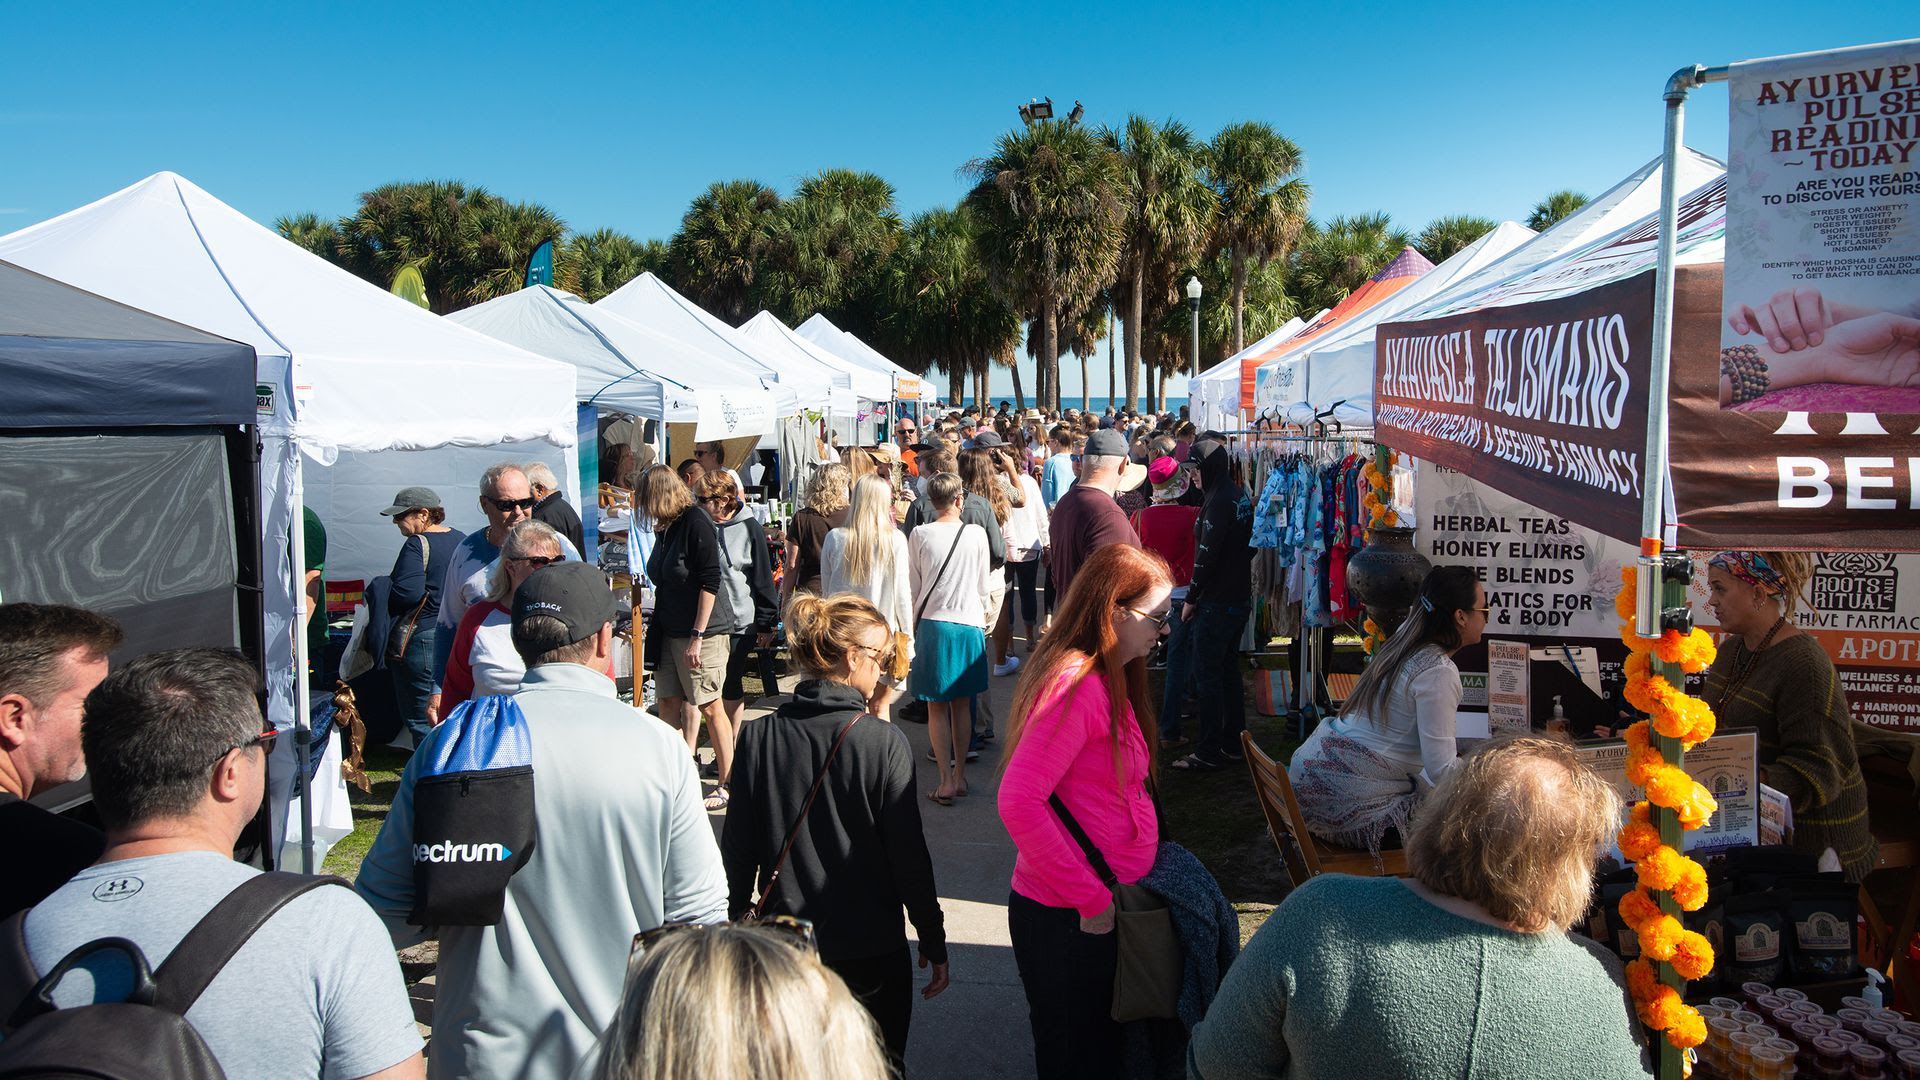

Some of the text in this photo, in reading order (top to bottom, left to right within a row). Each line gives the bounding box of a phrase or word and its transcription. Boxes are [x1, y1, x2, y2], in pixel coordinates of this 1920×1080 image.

[1757, 63, 1920, 106] AYURVE
[1804, 89, 1920, 125] PULSE
[1810, 141, 1917, 171] TODAY
[1795, 171, 1920, 192] ARE YOU READY
[1761, 194, 1782, 206] TO
[1786, 188, 1864, 204] DISCOVER
[1810, 208, 1846, 216] STRESS
[1863, 203, 1909, 213] ANXIETY?
[1823, 211, 1892, 222] OVER WEIGHT?
[1813, 217, 1902, 229] DIGESTIVE ISSUES?
[1820, 224, 1897, 235] SHORT TEMPER?
[1844, 237, 1893, 246] FLASHES?
[1850, 231, 1889, 239] ISSUES?
[1832, 244, 1883, 253] INSOMNIA?
[1762, 261, 1801, 269] IDENTIFY
[1879, 255, 1920, 263] CAUSING
[1826, 264, 1852, 272] WHAT
[1854, 263, 1873, 271] YOU
[1825, 271, 1851, 279] BACK
[1876, 268, 1920, 276] BALANCE
[1382, 313, 1630, 430] AYAHUASCA TALISMANS
[1377, 403, 1641, 498] AYURVEDA APOTHECARY & BEEHIVE FARMACY
[1776, 456, 1920, 510] BE
[1433, 515, 1570, 535] HERBAL TEAS
[1432, 540, 1585, 560] HONEY ELIXIRS
[1496, 567, 1574, 585] BLENDS
[1814, 576, 1880, 594] ROOTS
[1883, 578, 1895, 602] AND
[1484, 591, 1592, 611] ATICS FOR
[1814, 592, 1890, 610] RITUAL
[1497, 609, 1574, 627] & BODY
[1838, 637, 1920, 662] APOT
[1839, 671, 1900, 683] WELLNESS
[1904, 674, 1913, 683] &
[1841, 682, 1893, 693] BALANCE
[1851, 701, 1860, 711] &
[1862, 714, 1899, 726] YOUR
